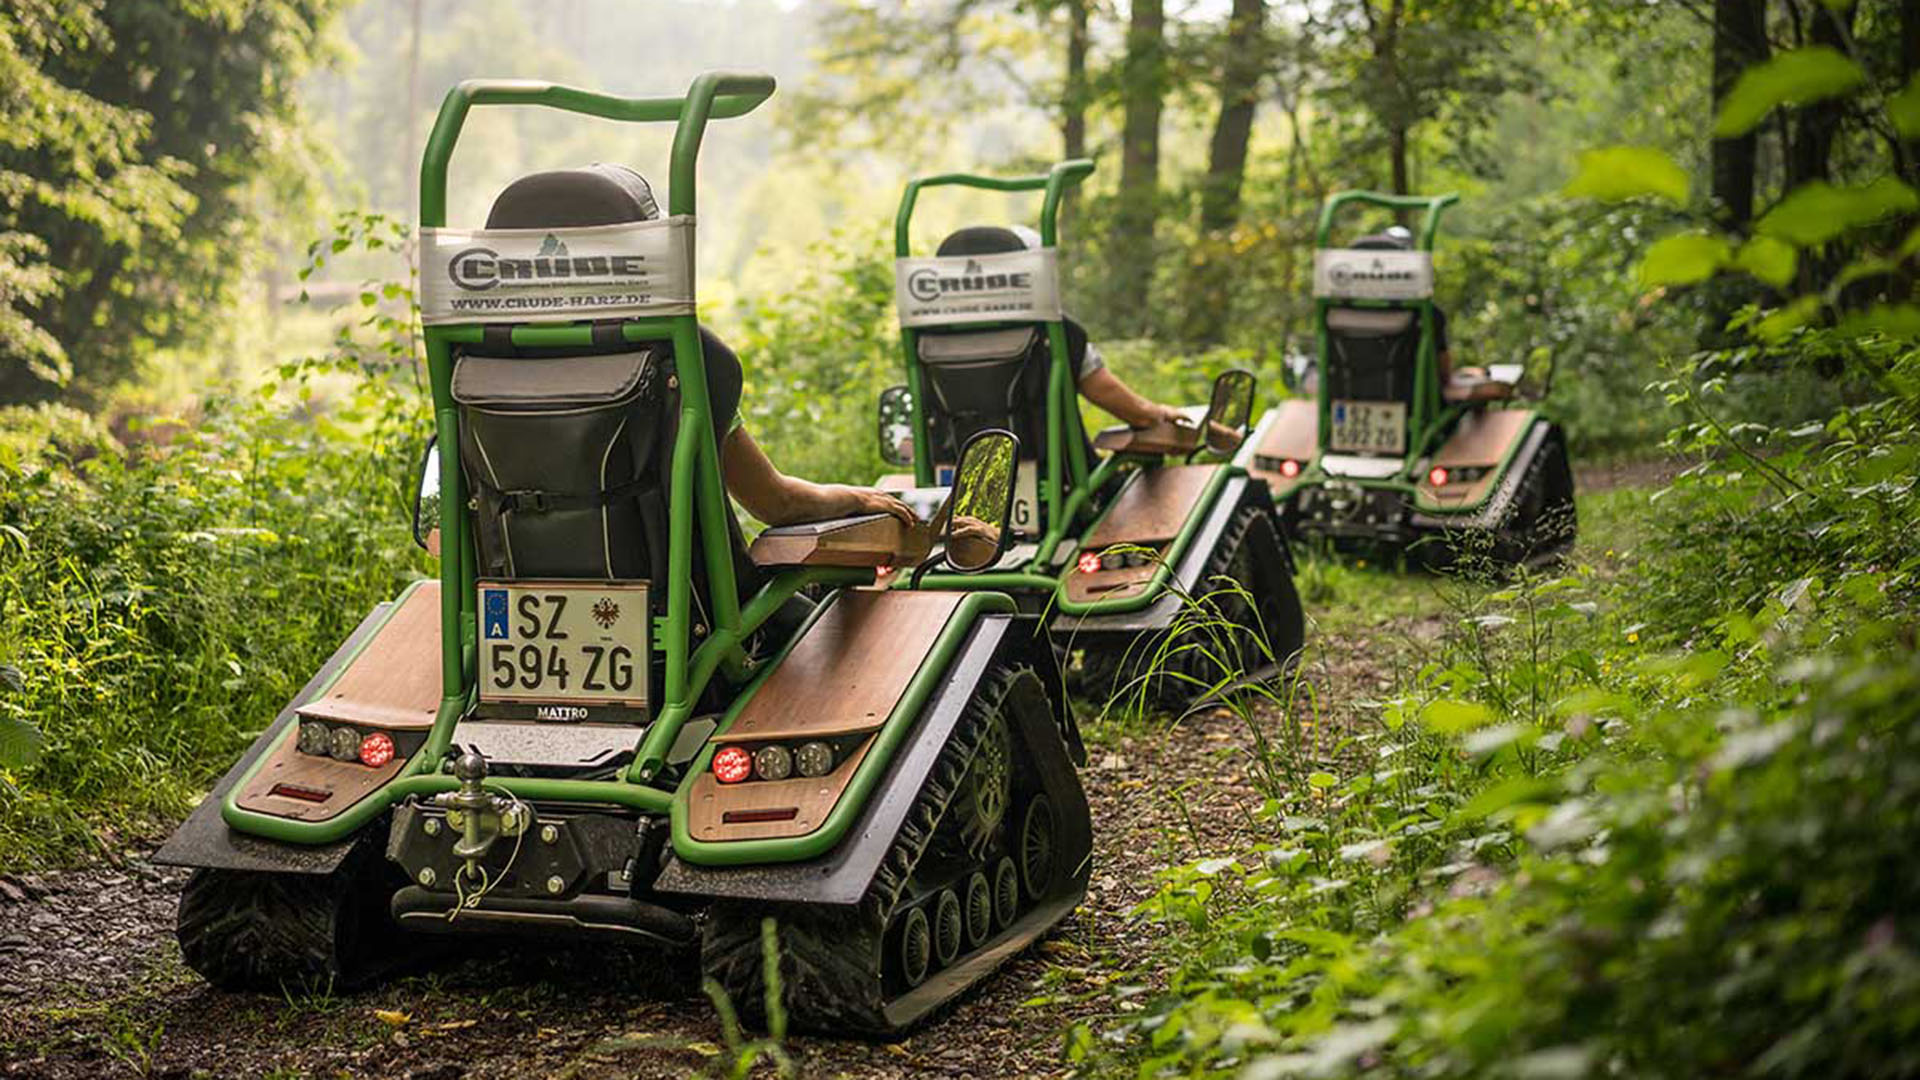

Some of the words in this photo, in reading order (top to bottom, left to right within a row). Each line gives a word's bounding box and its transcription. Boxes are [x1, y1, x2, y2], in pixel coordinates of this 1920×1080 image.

[448, 248, 647, 291] CRUDE
[908, 269, 1031, 302] CRUDE
[450, 294, 651, 310] WWW.CRUDE-HARZ.DE
[1014, 499, 1029, 525] G
[490, 622, 503, 637] A
[517, 594, 568, 640] SZ
[492, 644, 569, 690] 594
[582, 646, 633, 692] ZG
[537, 706, 588, 720] MATTRO
